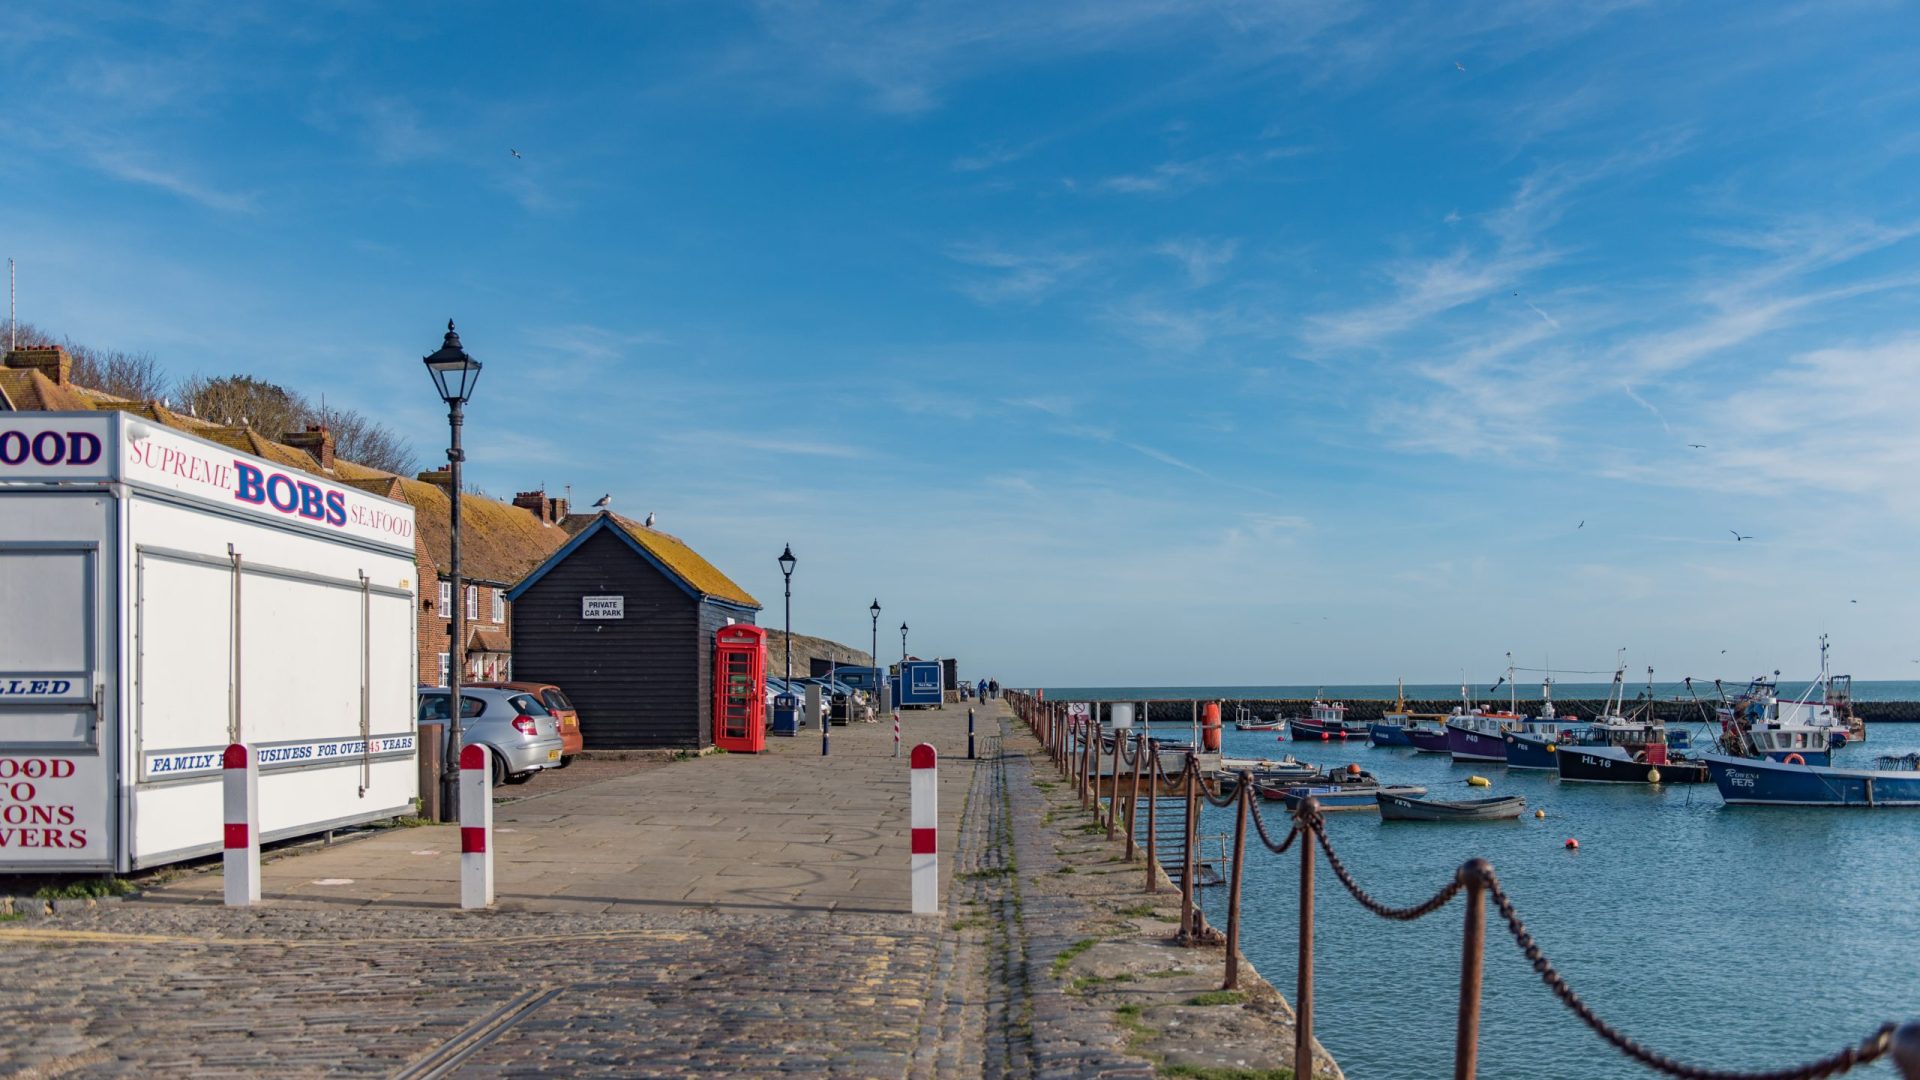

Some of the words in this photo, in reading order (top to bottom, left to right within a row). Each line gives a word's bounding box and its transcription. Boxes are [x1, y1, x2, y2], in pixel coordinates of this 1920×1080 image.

[0, 430, 102, 466] OOD
[130, 442, 231, 490] SUPREME
[233, 459, 347, 528] BOBS
[350, 503, 412, 538] SEAFOOD
[584, 609, 600, 617] CAR
[602, 609, 622, 617] PARK
[588, 601, 618, 609] PRIVATE
[0, 680, 71, 695] LED
[151, 754, 215, 773] FAMILY
[257, 745, 312, 762] USINESS
[317, 743, 337, 757] FOR
[369, 741, 380, 752] 45
[382, 737, 413, 750] YEARS
[1581, 755, 1597, 765] HL
[1599, 759, 1612, 768] 16
[0, 758, 75, 779] OOD
[1731, 777, 1755, 787] FE75
[0, 804, 75, 826] ONS
